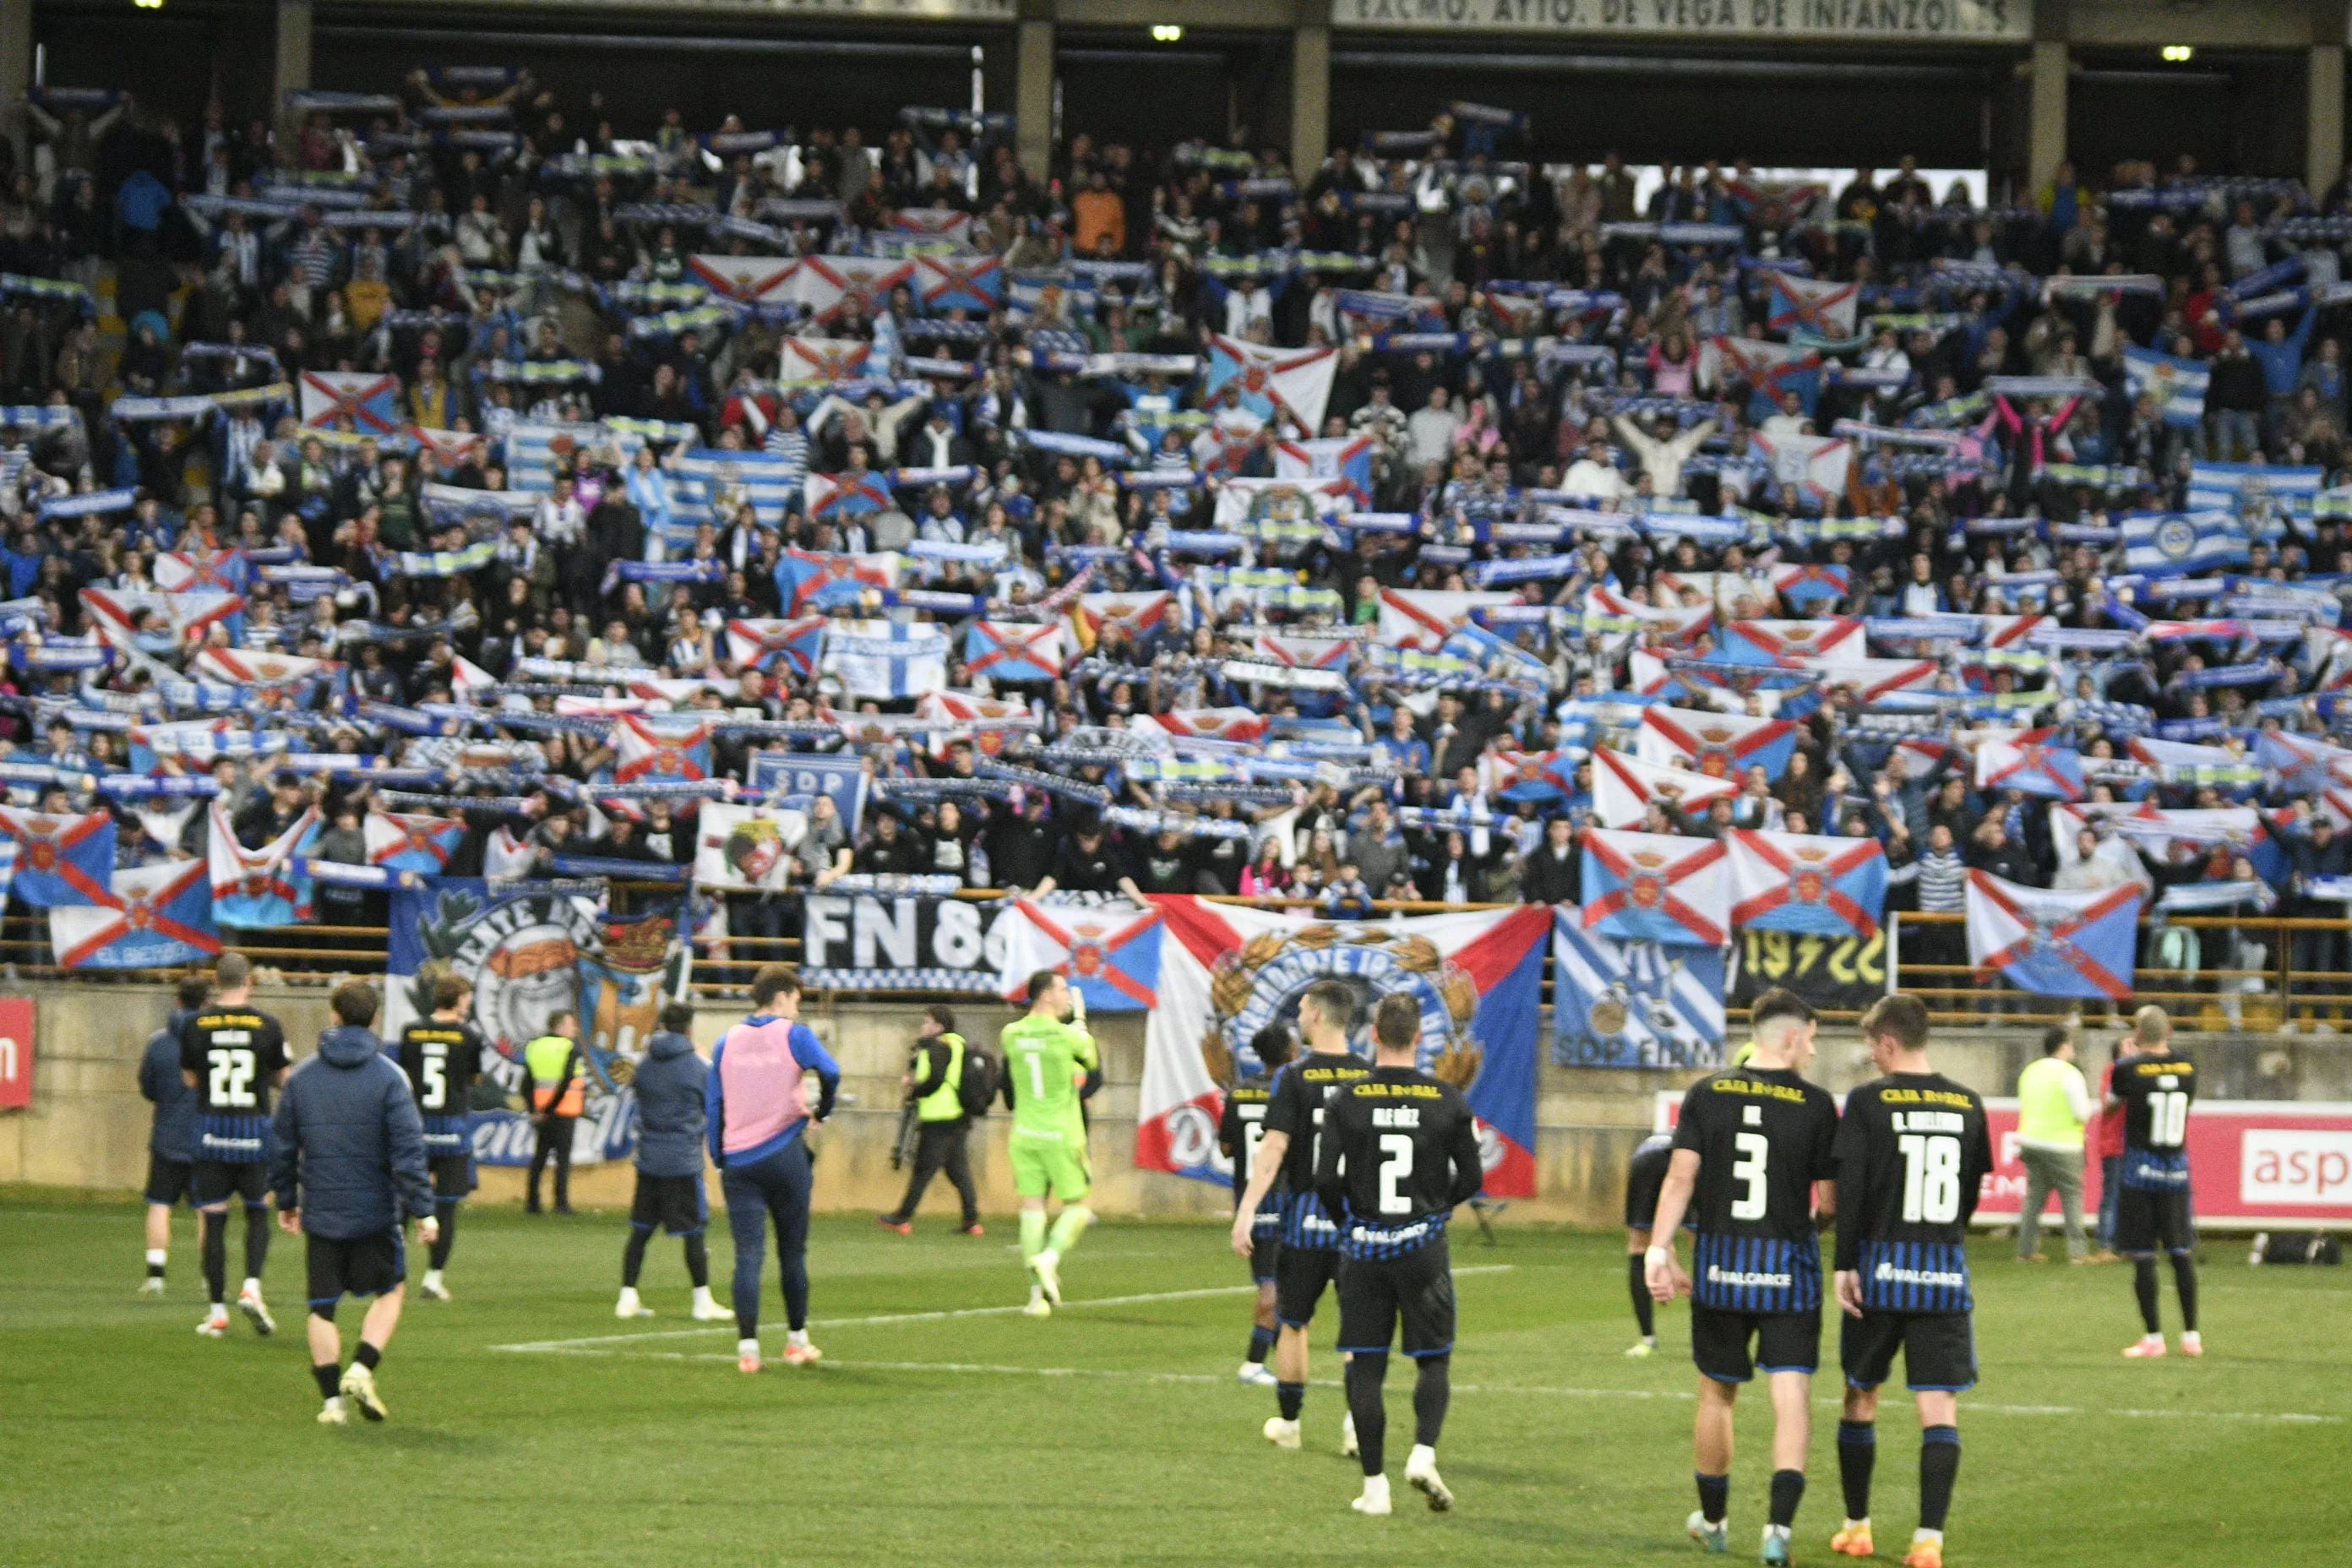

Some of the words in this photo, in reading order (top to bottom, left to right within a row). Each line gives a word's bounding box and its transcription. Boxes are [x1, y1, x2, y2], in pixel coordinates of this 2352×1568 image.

[804, 895, 917, 969] FN
[207, 1049, 257, 1107] 22
[422, 1056, 446, 1109] 5
[1024, 1052, 1046, 1099] 1
[2147, 1092, 2189, 1147] 10
[1379, 1134, 1414, 1215] 2
[1730, 1132, 1769, 1221] 3
[1898, 1134, 1962, 1225] 18
